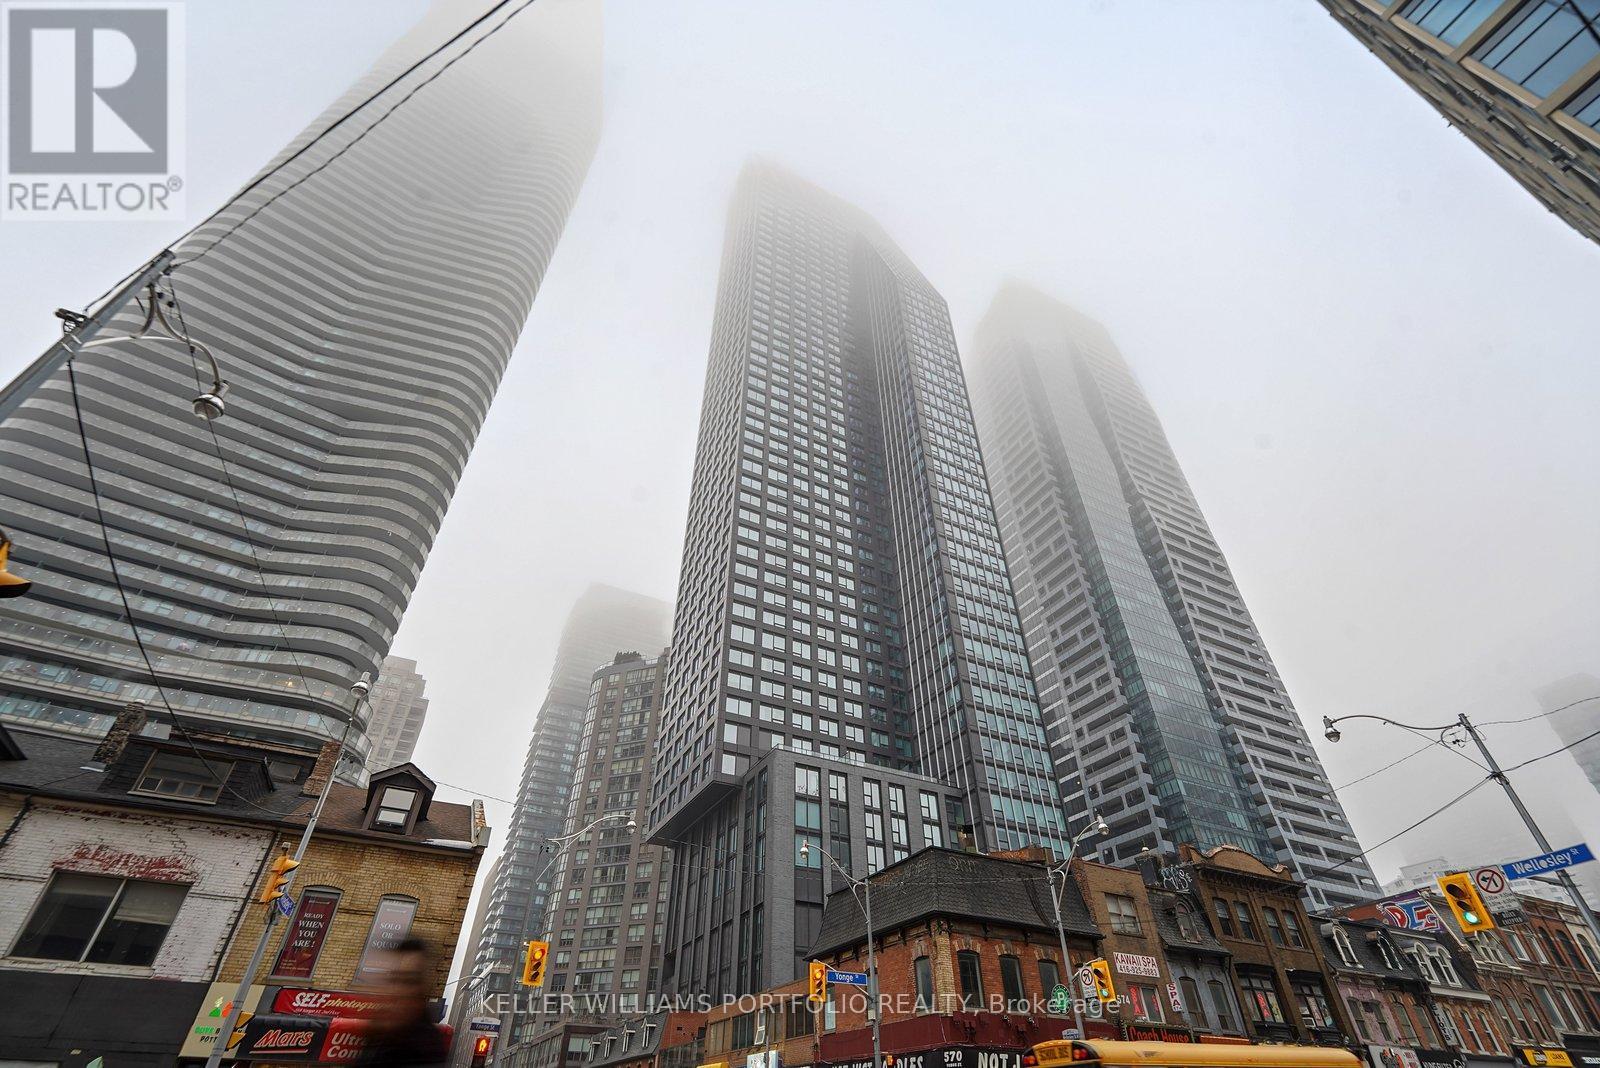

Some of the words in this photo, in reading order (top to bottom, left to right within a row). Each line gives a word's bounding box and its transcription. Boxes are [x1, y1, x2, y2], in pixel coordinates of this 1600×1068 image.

[298, 920, 325, 929] WHEN
[380, 922, 401, 931] SOLO
[299, 929, 318, 938] YOU
[381, 931, 394, 939] OR
[1141, 956, 1158, 968] SPA
[834, 972, 854, 983] Yonge
[1116, 994, 1130, 1005] 574
[1168, 982, 1181, 1006] SPA
[253, 1029, 316, 1048] Mars
[943, 1050, 963, 1063] 570
[978, 1052, 1009, 1068] NOT
